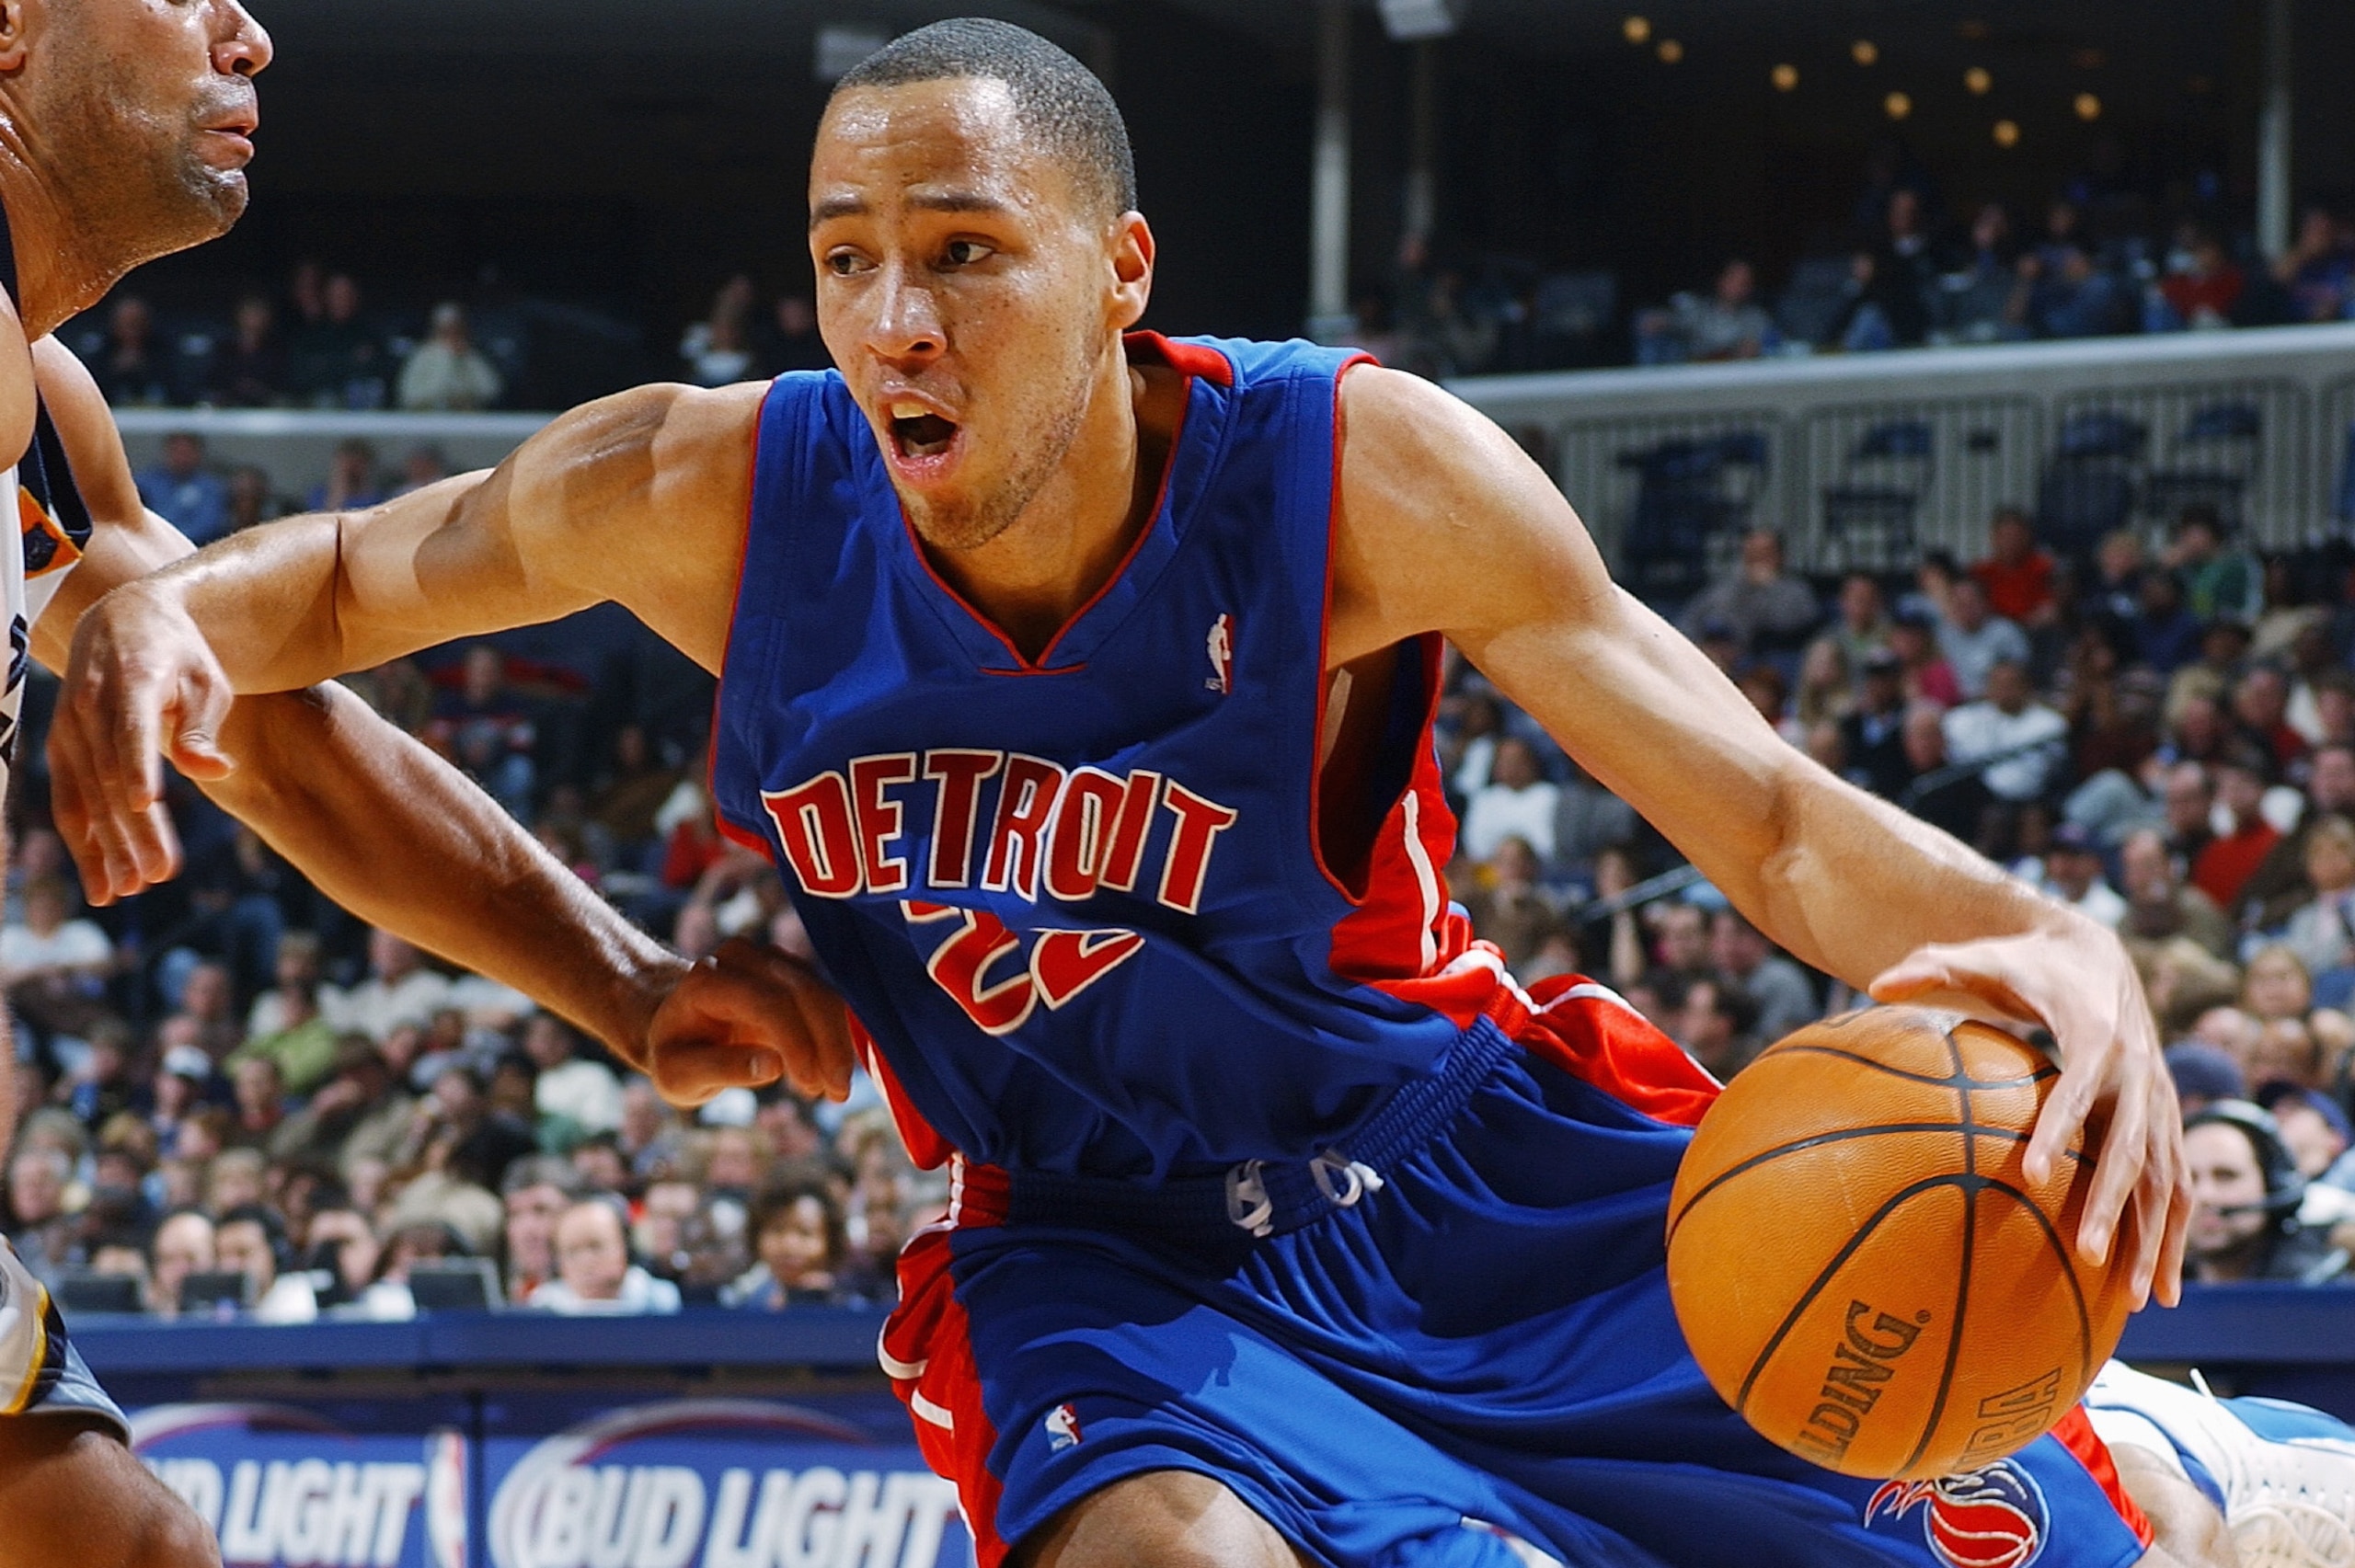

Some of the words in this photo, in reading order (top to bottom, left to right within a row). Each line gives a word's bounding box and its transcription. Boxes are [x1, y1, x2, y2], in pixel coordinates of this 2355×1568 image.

[760, 748, 1238, 915] DETROIT
[1794, 1299, 1922, 1462] LDING
[1948, 1367, 2062, 1472] BA
[220, 1459, 425, 1562] LIGHT
[532, 1465, 706, 1568] BUD
[703, 1466, 959, 1568] LIGHT
